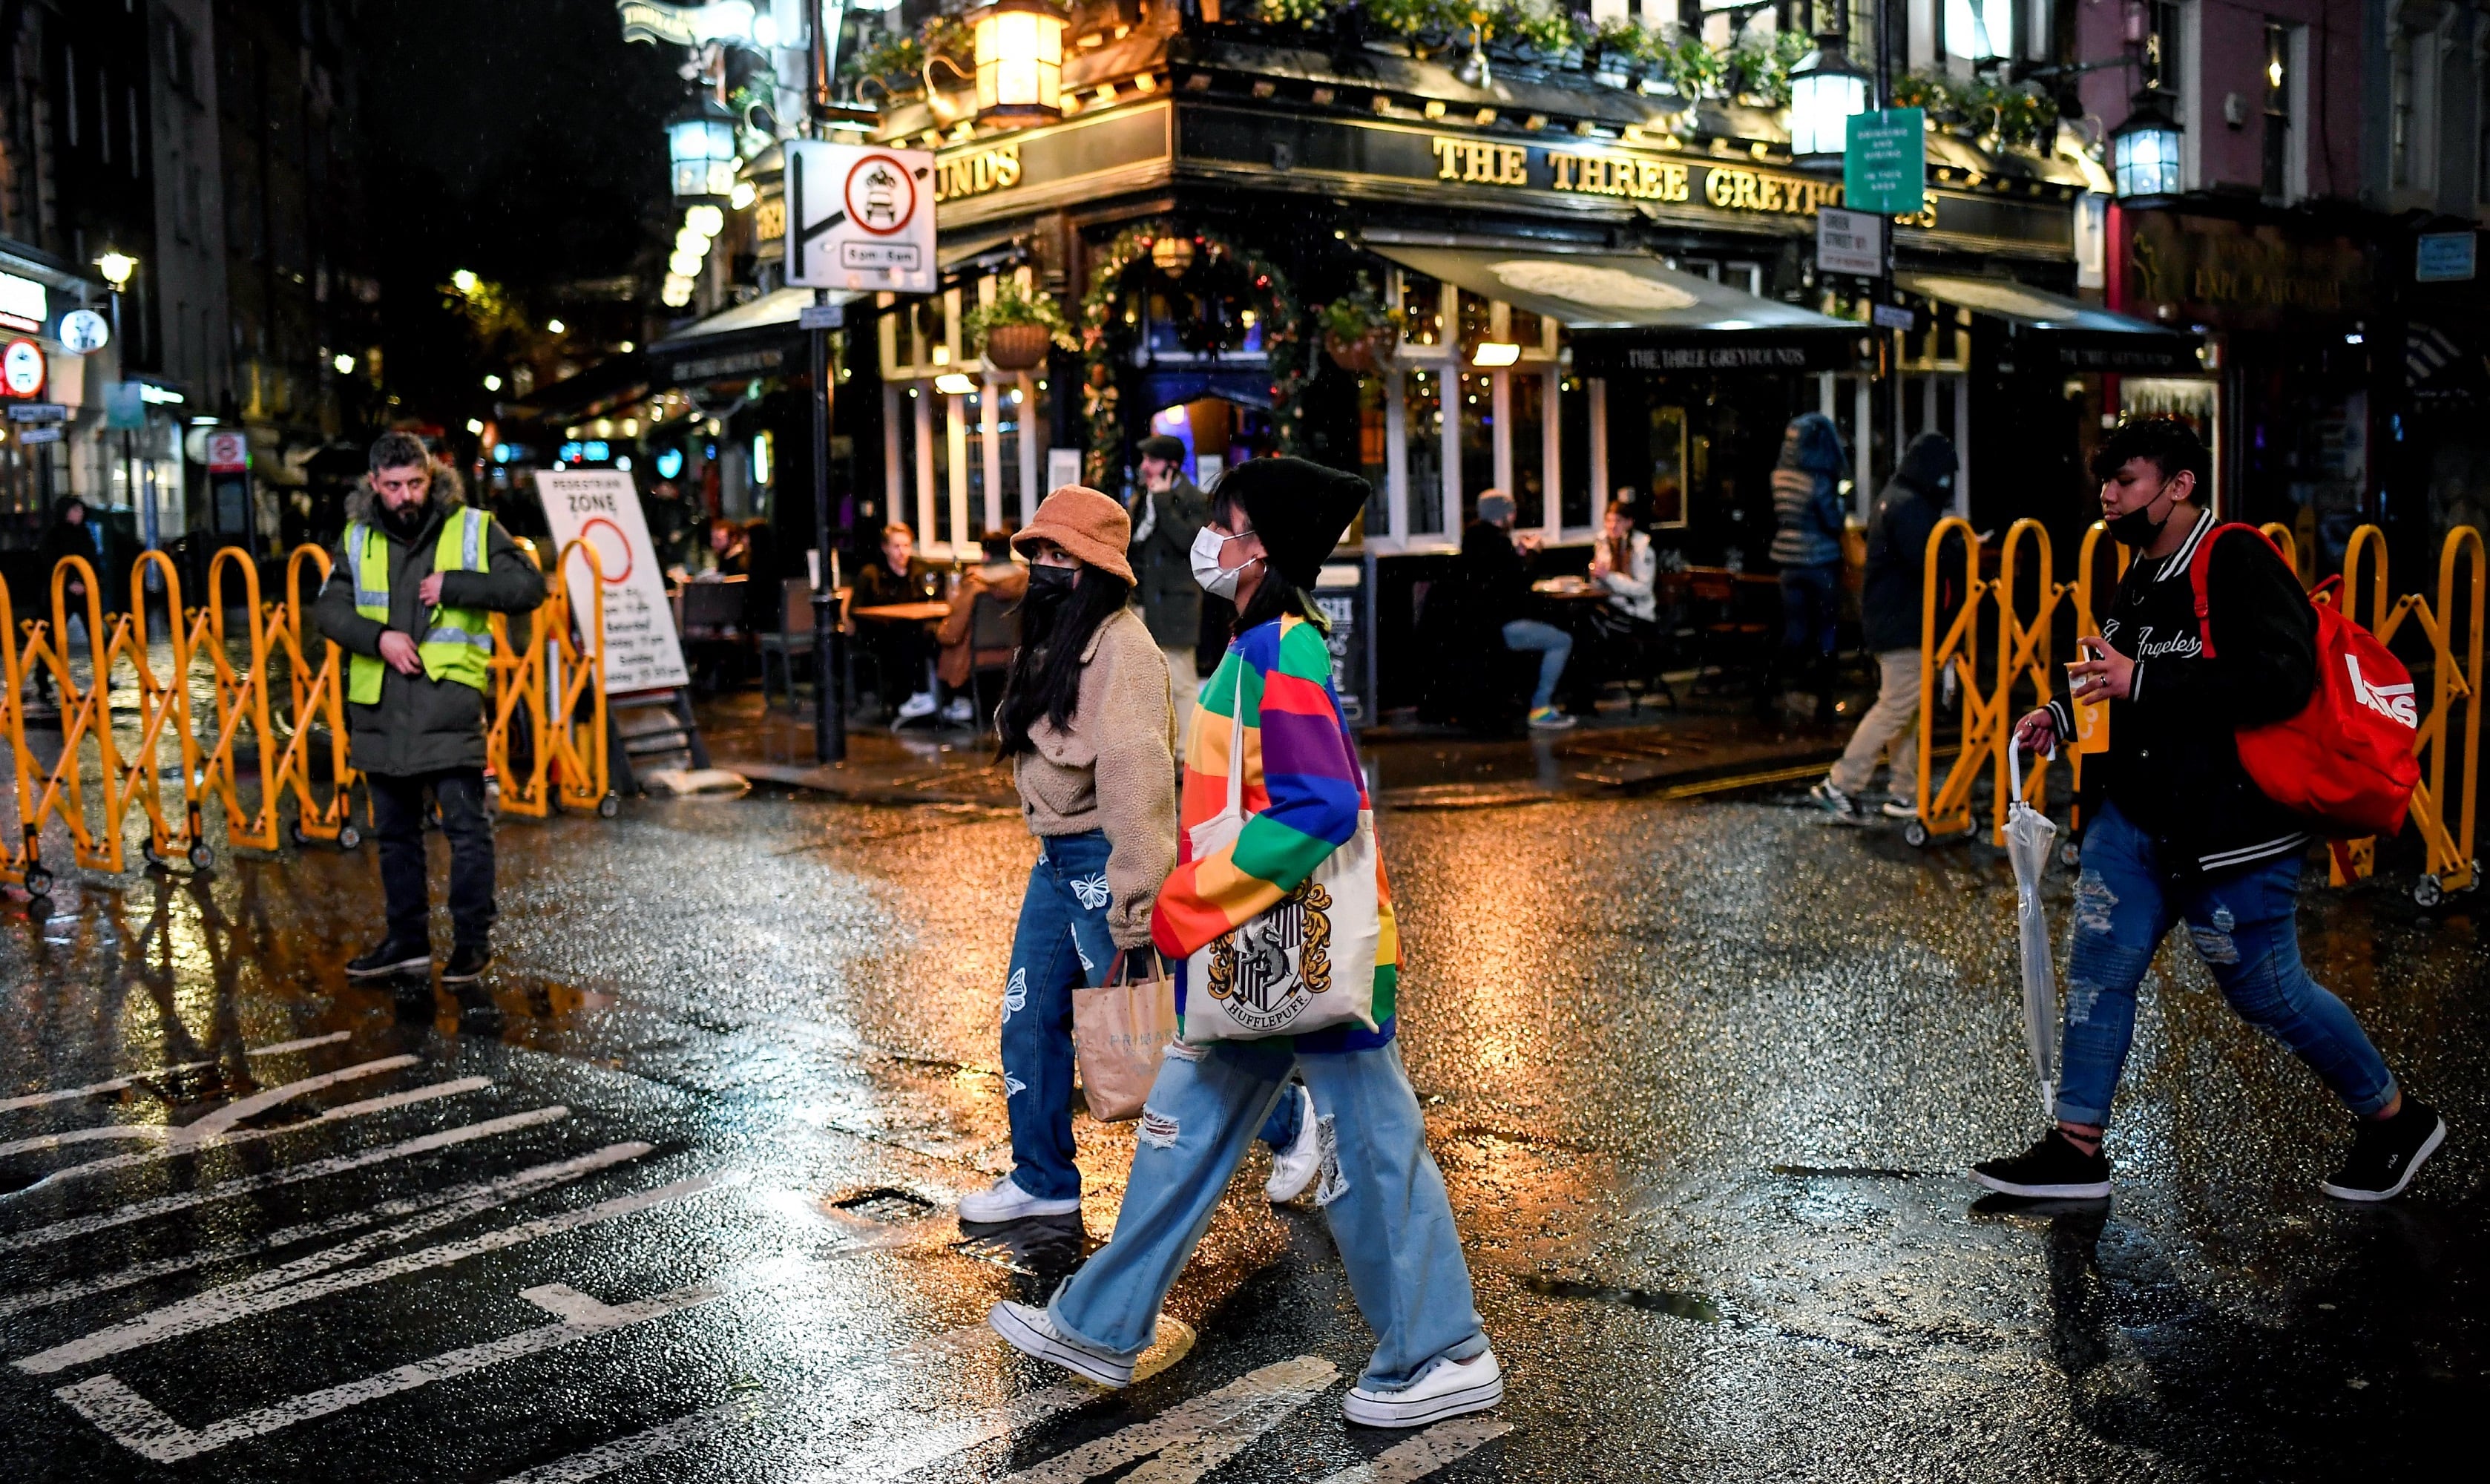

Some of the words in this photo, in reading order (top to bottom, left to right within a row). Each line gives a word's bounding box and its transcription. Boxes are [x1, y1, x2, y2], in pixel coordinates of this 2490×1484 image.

[1433, 137, 1528, 186] THE
[1548, 151, 1689, 202] THREE
[1705, 168, 1937, 229] GREYHOS
[1629, 348, 1660, 369] THE
[567, 493, 617, 513] ZONE
[2138, 627, 2202, 662] Angeles
[2345, 653, 2418, 729] VANS
[1228, 995, 1306, 1028] HUFFLEPUFF
[1110, 1028, 1172, 1048] PRIMAR
